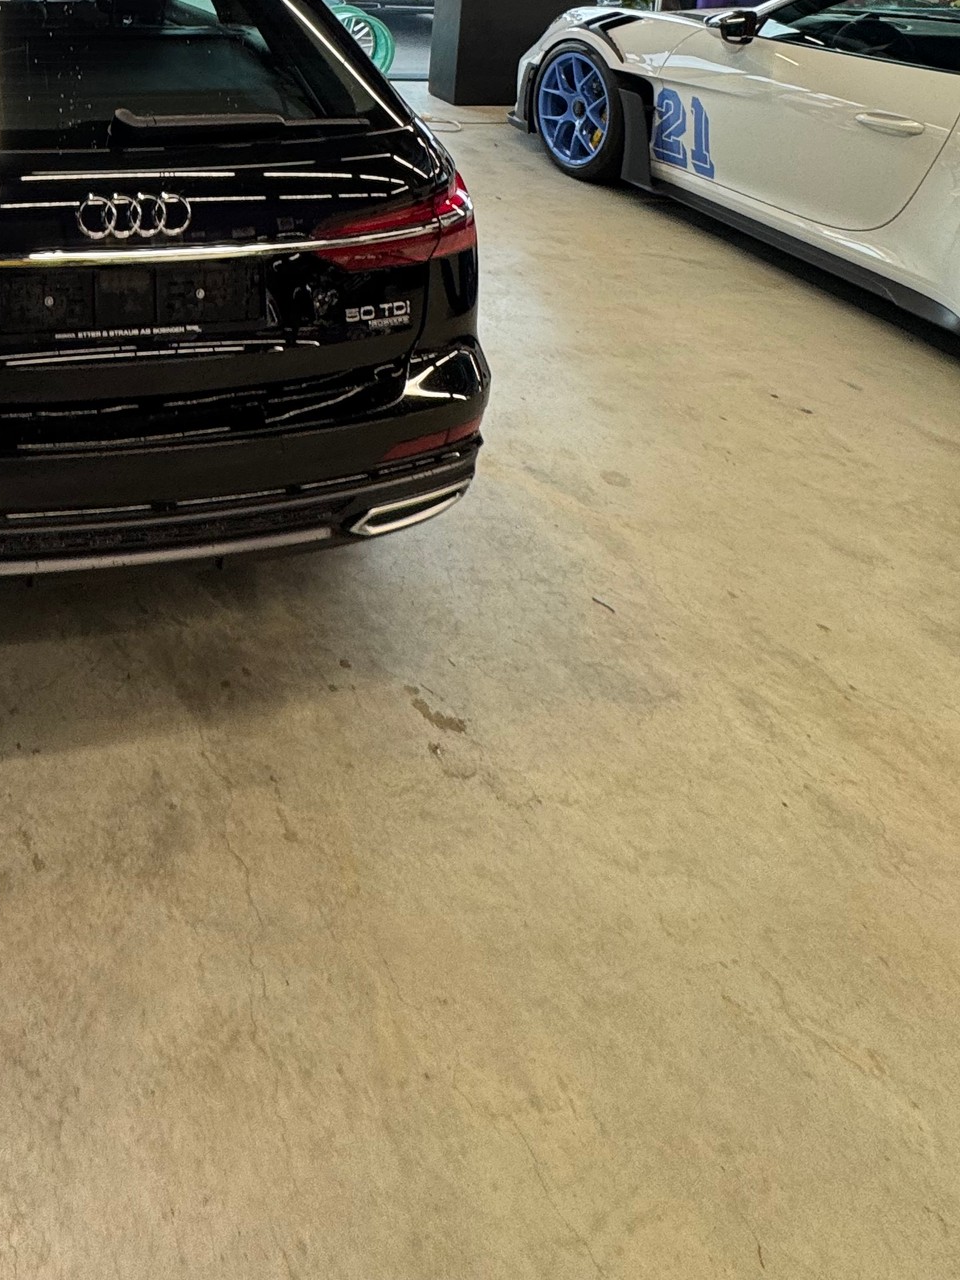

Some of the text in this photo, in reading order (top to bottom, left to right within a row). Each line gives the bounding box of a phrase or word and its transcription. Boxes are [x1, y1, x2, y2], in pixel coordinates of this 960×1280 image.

[652, 87, 715, 180] 21
[344, 300, 411, 322] 50 TDI
